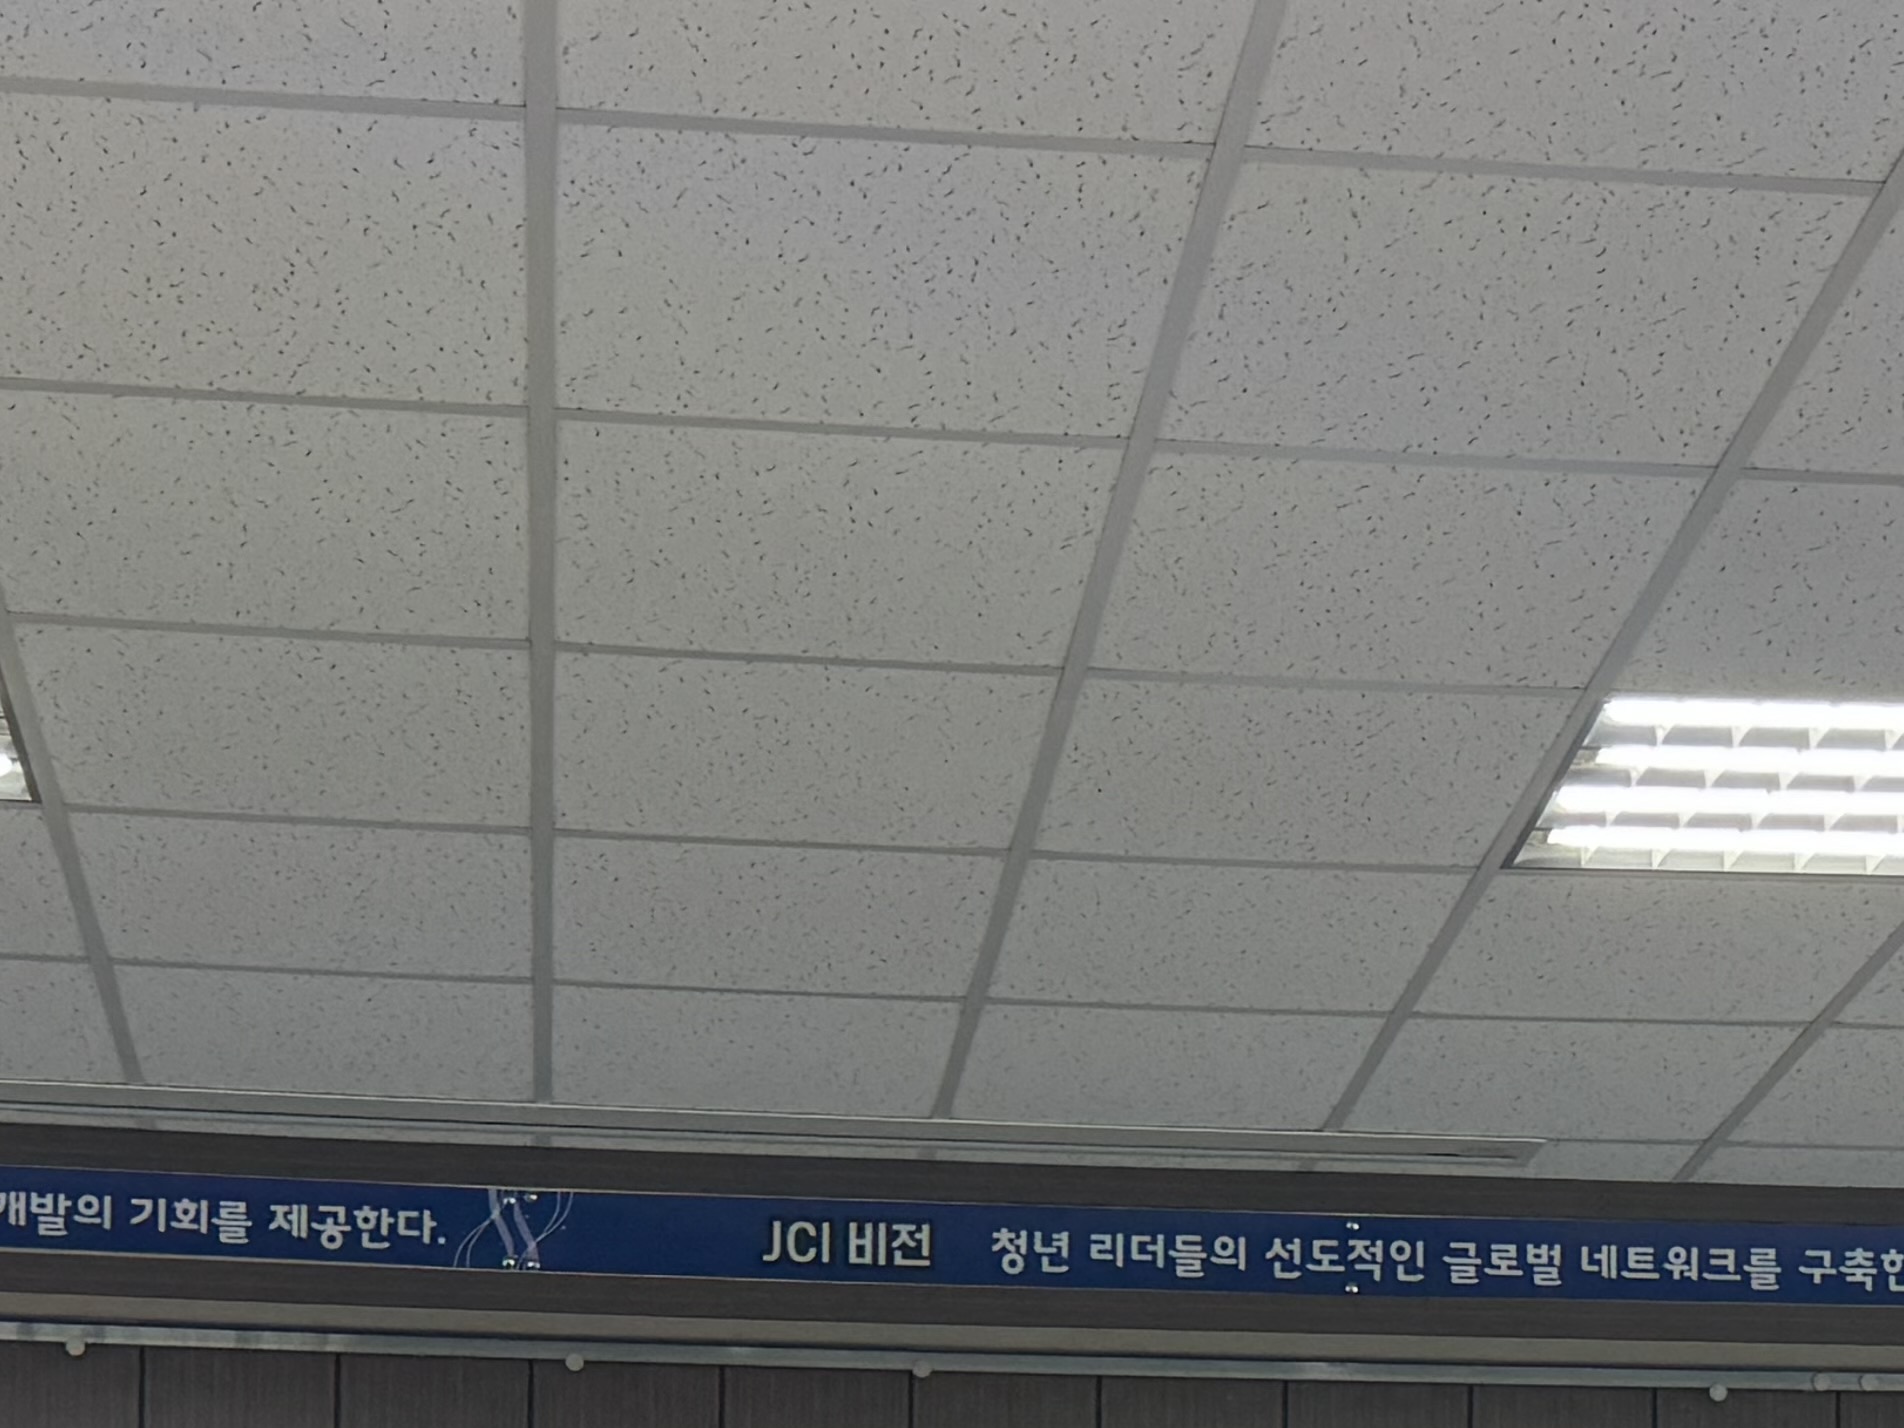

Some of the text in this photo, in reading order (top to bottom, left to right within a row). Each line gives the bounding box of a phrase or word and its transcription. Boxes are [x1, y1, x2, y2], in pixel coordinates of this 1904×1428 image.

[129, 1196, 250, 1245] 기회를
[268, 1200, 446, 1251] 제공한다.
[762, 1221, 932, 1267] JCI 비전
[992, 1227, 1072, 1276] 청년
[1090, 1231, 1247, 1278] 리더들의
[1265, 1237, 1426, 1285] 선도적인
[1442, 1242, 1563, 1286] 글로벌
[1581, 1244, 1783, 1292] 네트워크를
